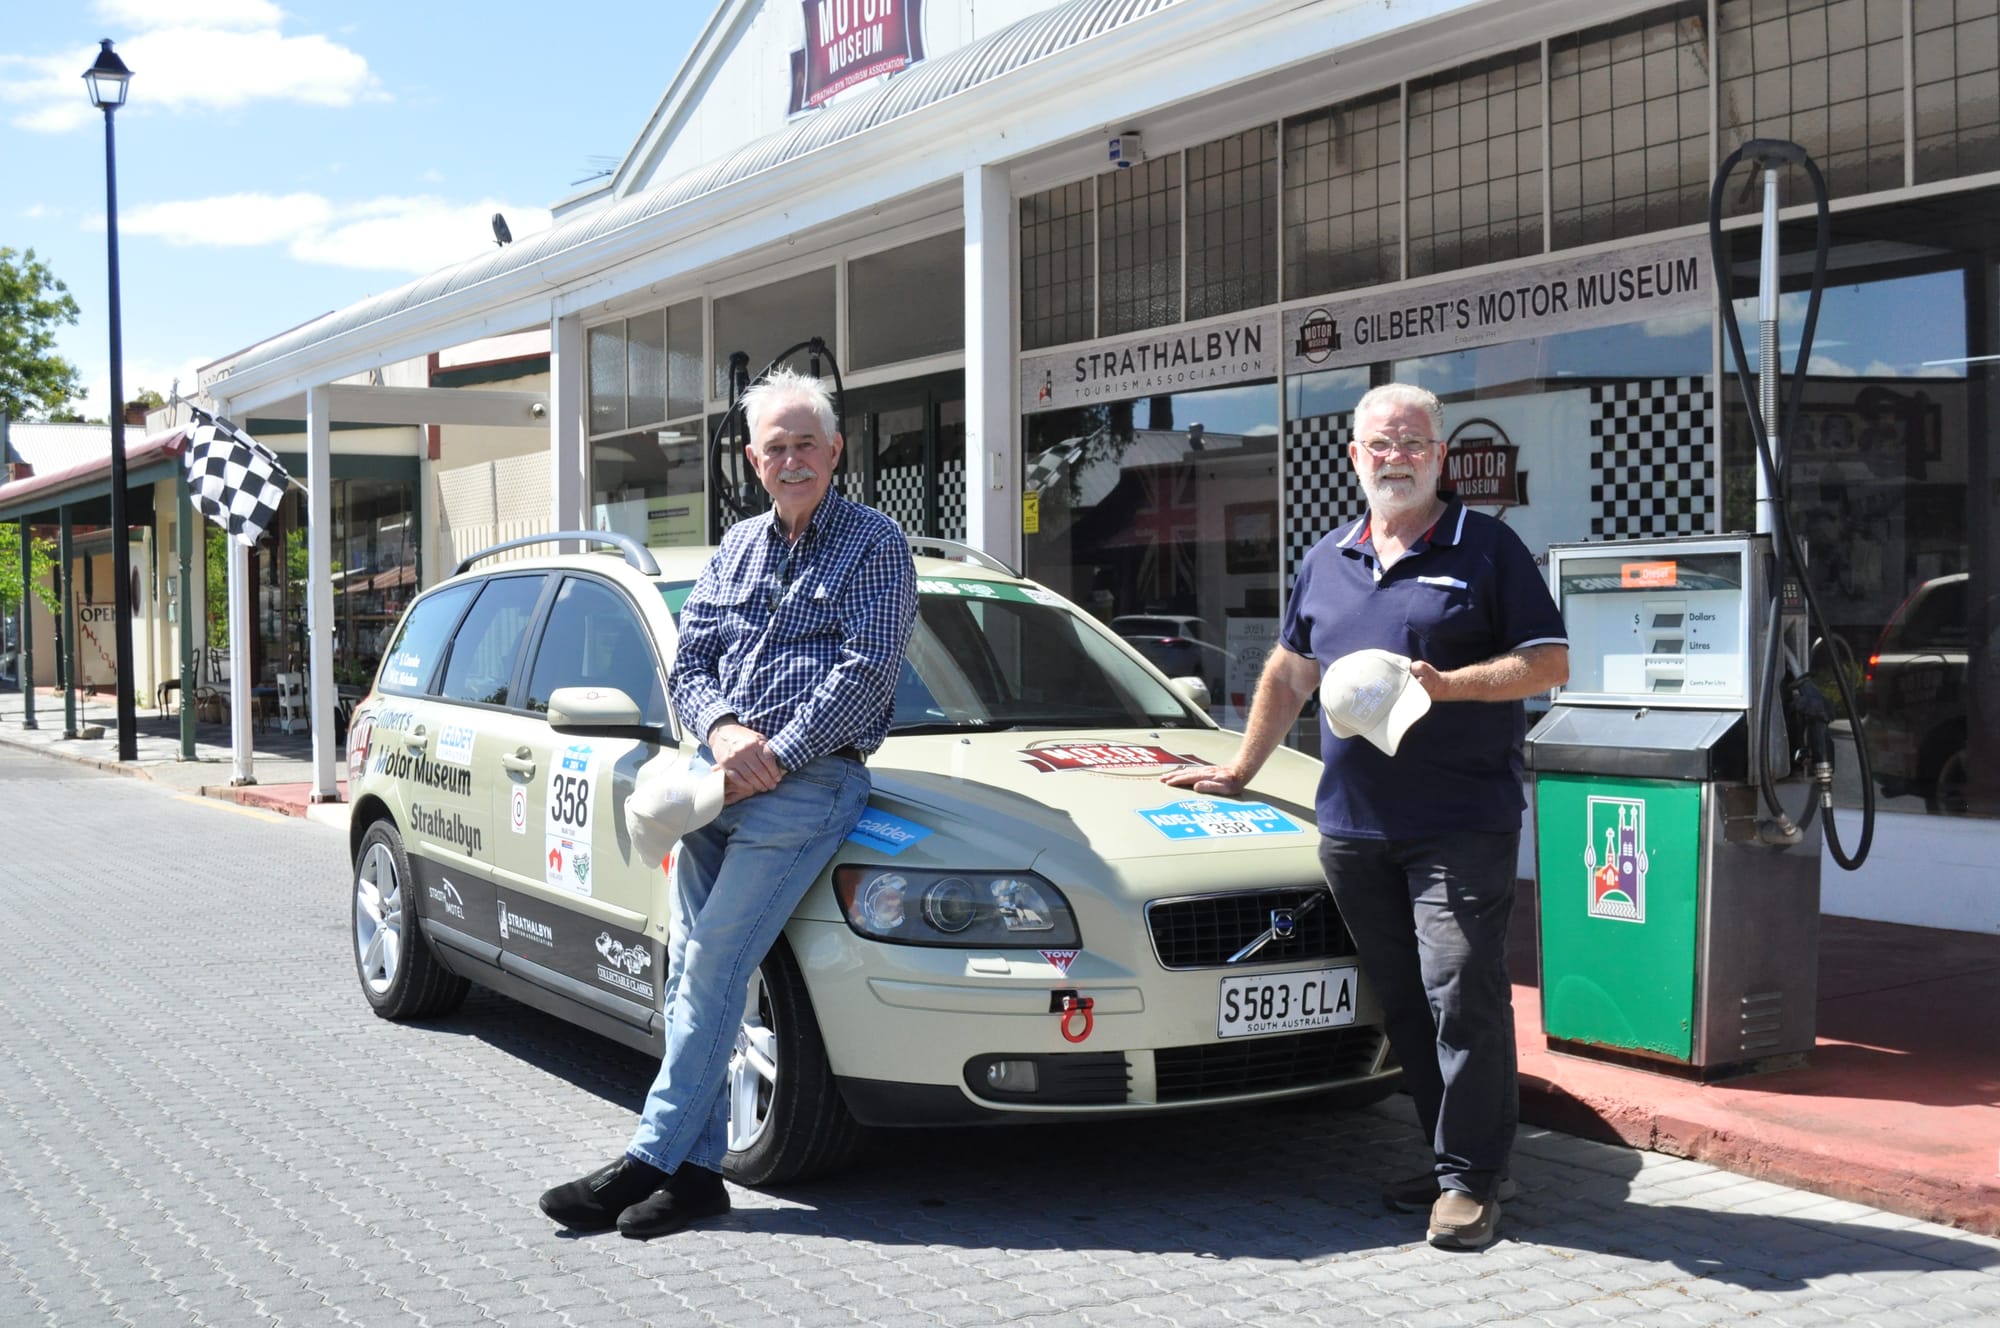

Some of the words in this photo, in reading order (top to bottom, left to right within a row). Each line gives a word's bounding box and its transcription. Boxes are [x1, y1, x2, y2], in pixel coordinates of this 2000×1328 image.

[828, 22, 883, 75] MUSEUM
[1354, 298, 1470, 345] GILBERT'S
[1478, 281, 1568, 326] MOTOR
[1577, 257, 1698, 308] MUSEUM
[1304, 324, 1332, 340] MOTOR
[1075, 325, 1261, 382] STRATHALBYN
[1075, 380, 1139, 398] TOURISM
[1146, 359, 1262, 388] ASSOCIATION
[1449, 451, 1507, 480] MOTOR
[1457, 478, 1500, 496] MUSEUM
[1634, 613, 1640, 625] $
[1689, 612, 1716, 622] Dollars
[1689, 641, 1711, 650] Litres
[1041, 746, 1158, 760] MOTOR
[374, 743, 413, 781] Motor
[414, 752, 472, 797] Museum
[551, 773, 589, 828] 358
[1149, 811, 1230, 827] ADELAIDE
[1227, 807, 1279, 822] RALLY
[1208, 821, 1252, 835] 358
[411, 802, 482, 857] Strathalbyn
[857, 819, 916, 842] calder
[445, 901, 465, 920] MOTEL
[508, 912, 553, 941] STRATHALBYN
[1044, 951, 1074, 959] TOW
[597, 967, 631, 989] COLLECTABLE
[630, 978, 654, 997] CLASSICS
[1247, 1022, 1278, 1032] SOUTH
[1281, 1016, 1330, 1029] AUSTRALIA
